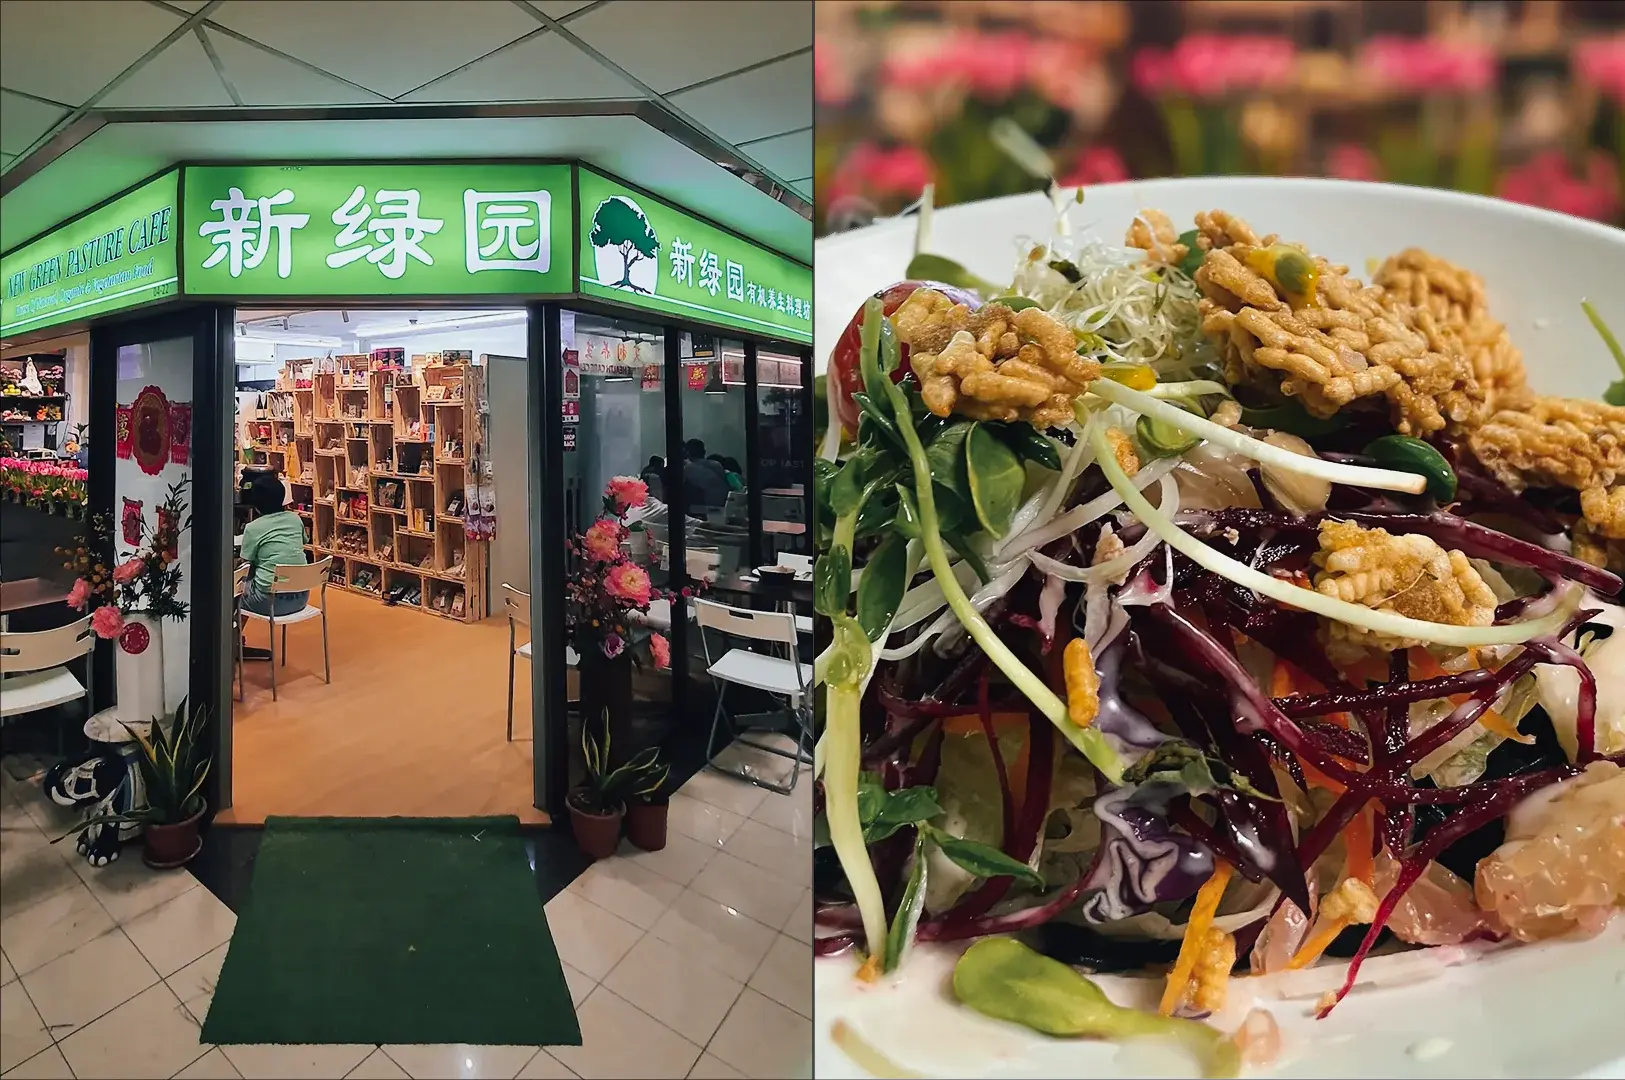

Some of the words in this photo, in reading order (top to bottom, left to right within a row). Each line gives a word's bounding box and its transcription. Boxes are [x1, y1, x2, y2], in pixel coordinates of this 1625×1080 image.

[8, 270, 27, 299] NEW
[29, 253, 64, 293] GREEN
[65, 225, 125, 277] PASTURE
[128, 206, 171, 254] CAFE
[199, 184, 551, 279] 新绿园
[153, 284, 169, 297] 04-22
[669, 236, 745, 303] 新绿园
[746, 280, 811, 321] 有机养生料理坊
